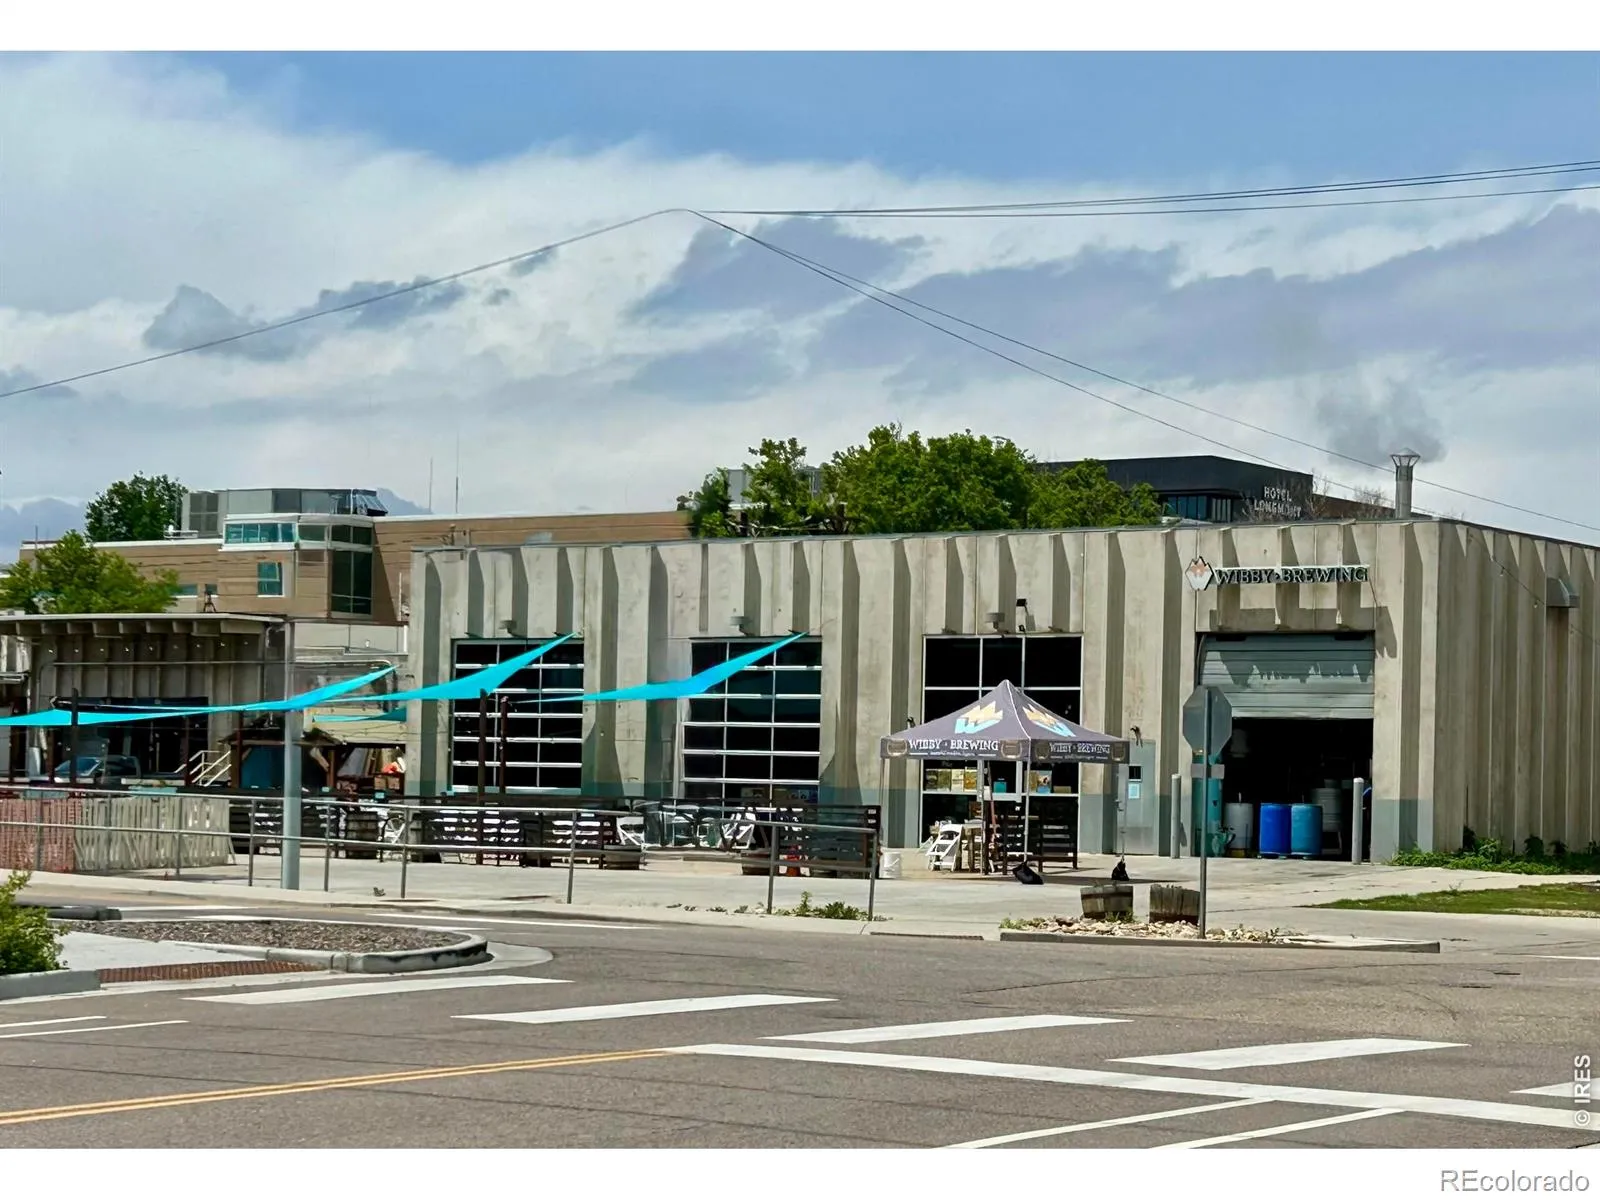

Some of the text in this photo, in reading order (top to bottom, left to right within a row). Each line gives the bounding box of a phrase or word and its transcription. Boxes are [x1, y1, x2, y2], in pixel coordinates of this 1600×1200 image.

[1264, 486, 1291, 501] HOTEL
[1213, 566, 1368, 584] WIBBY BREWING
[909, 739, 999, 751] WIBBY BREWING
